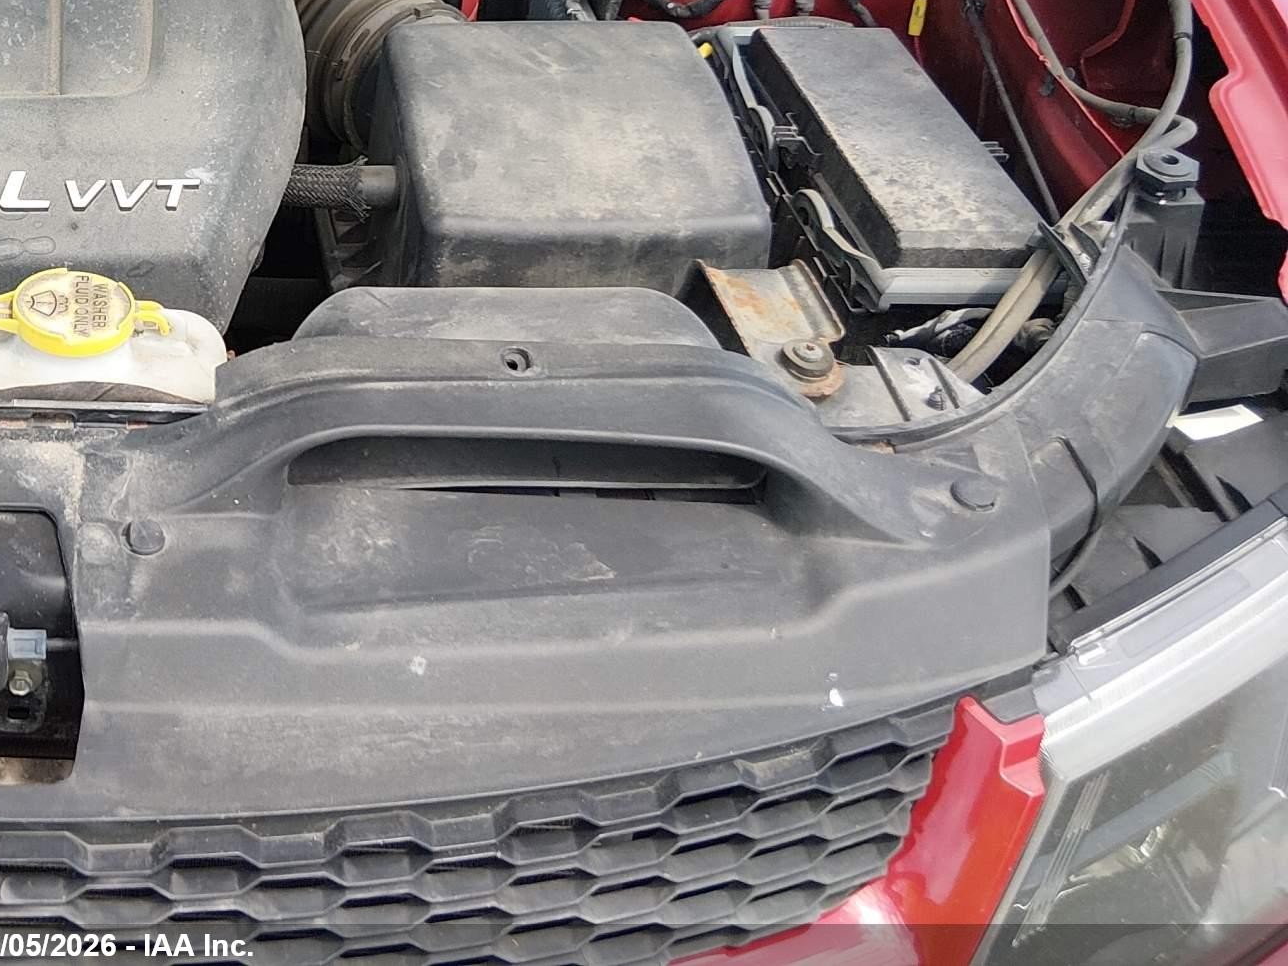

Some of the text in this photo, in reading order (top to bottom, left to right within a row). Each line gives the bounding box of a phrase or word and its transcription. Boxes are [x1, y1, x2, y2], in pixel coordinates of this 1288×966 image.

[64, 177, 201, 212] VVT
[73, 274, 90, 338] FLUID ONLY
[92, 283, 108, 328] WASHER
